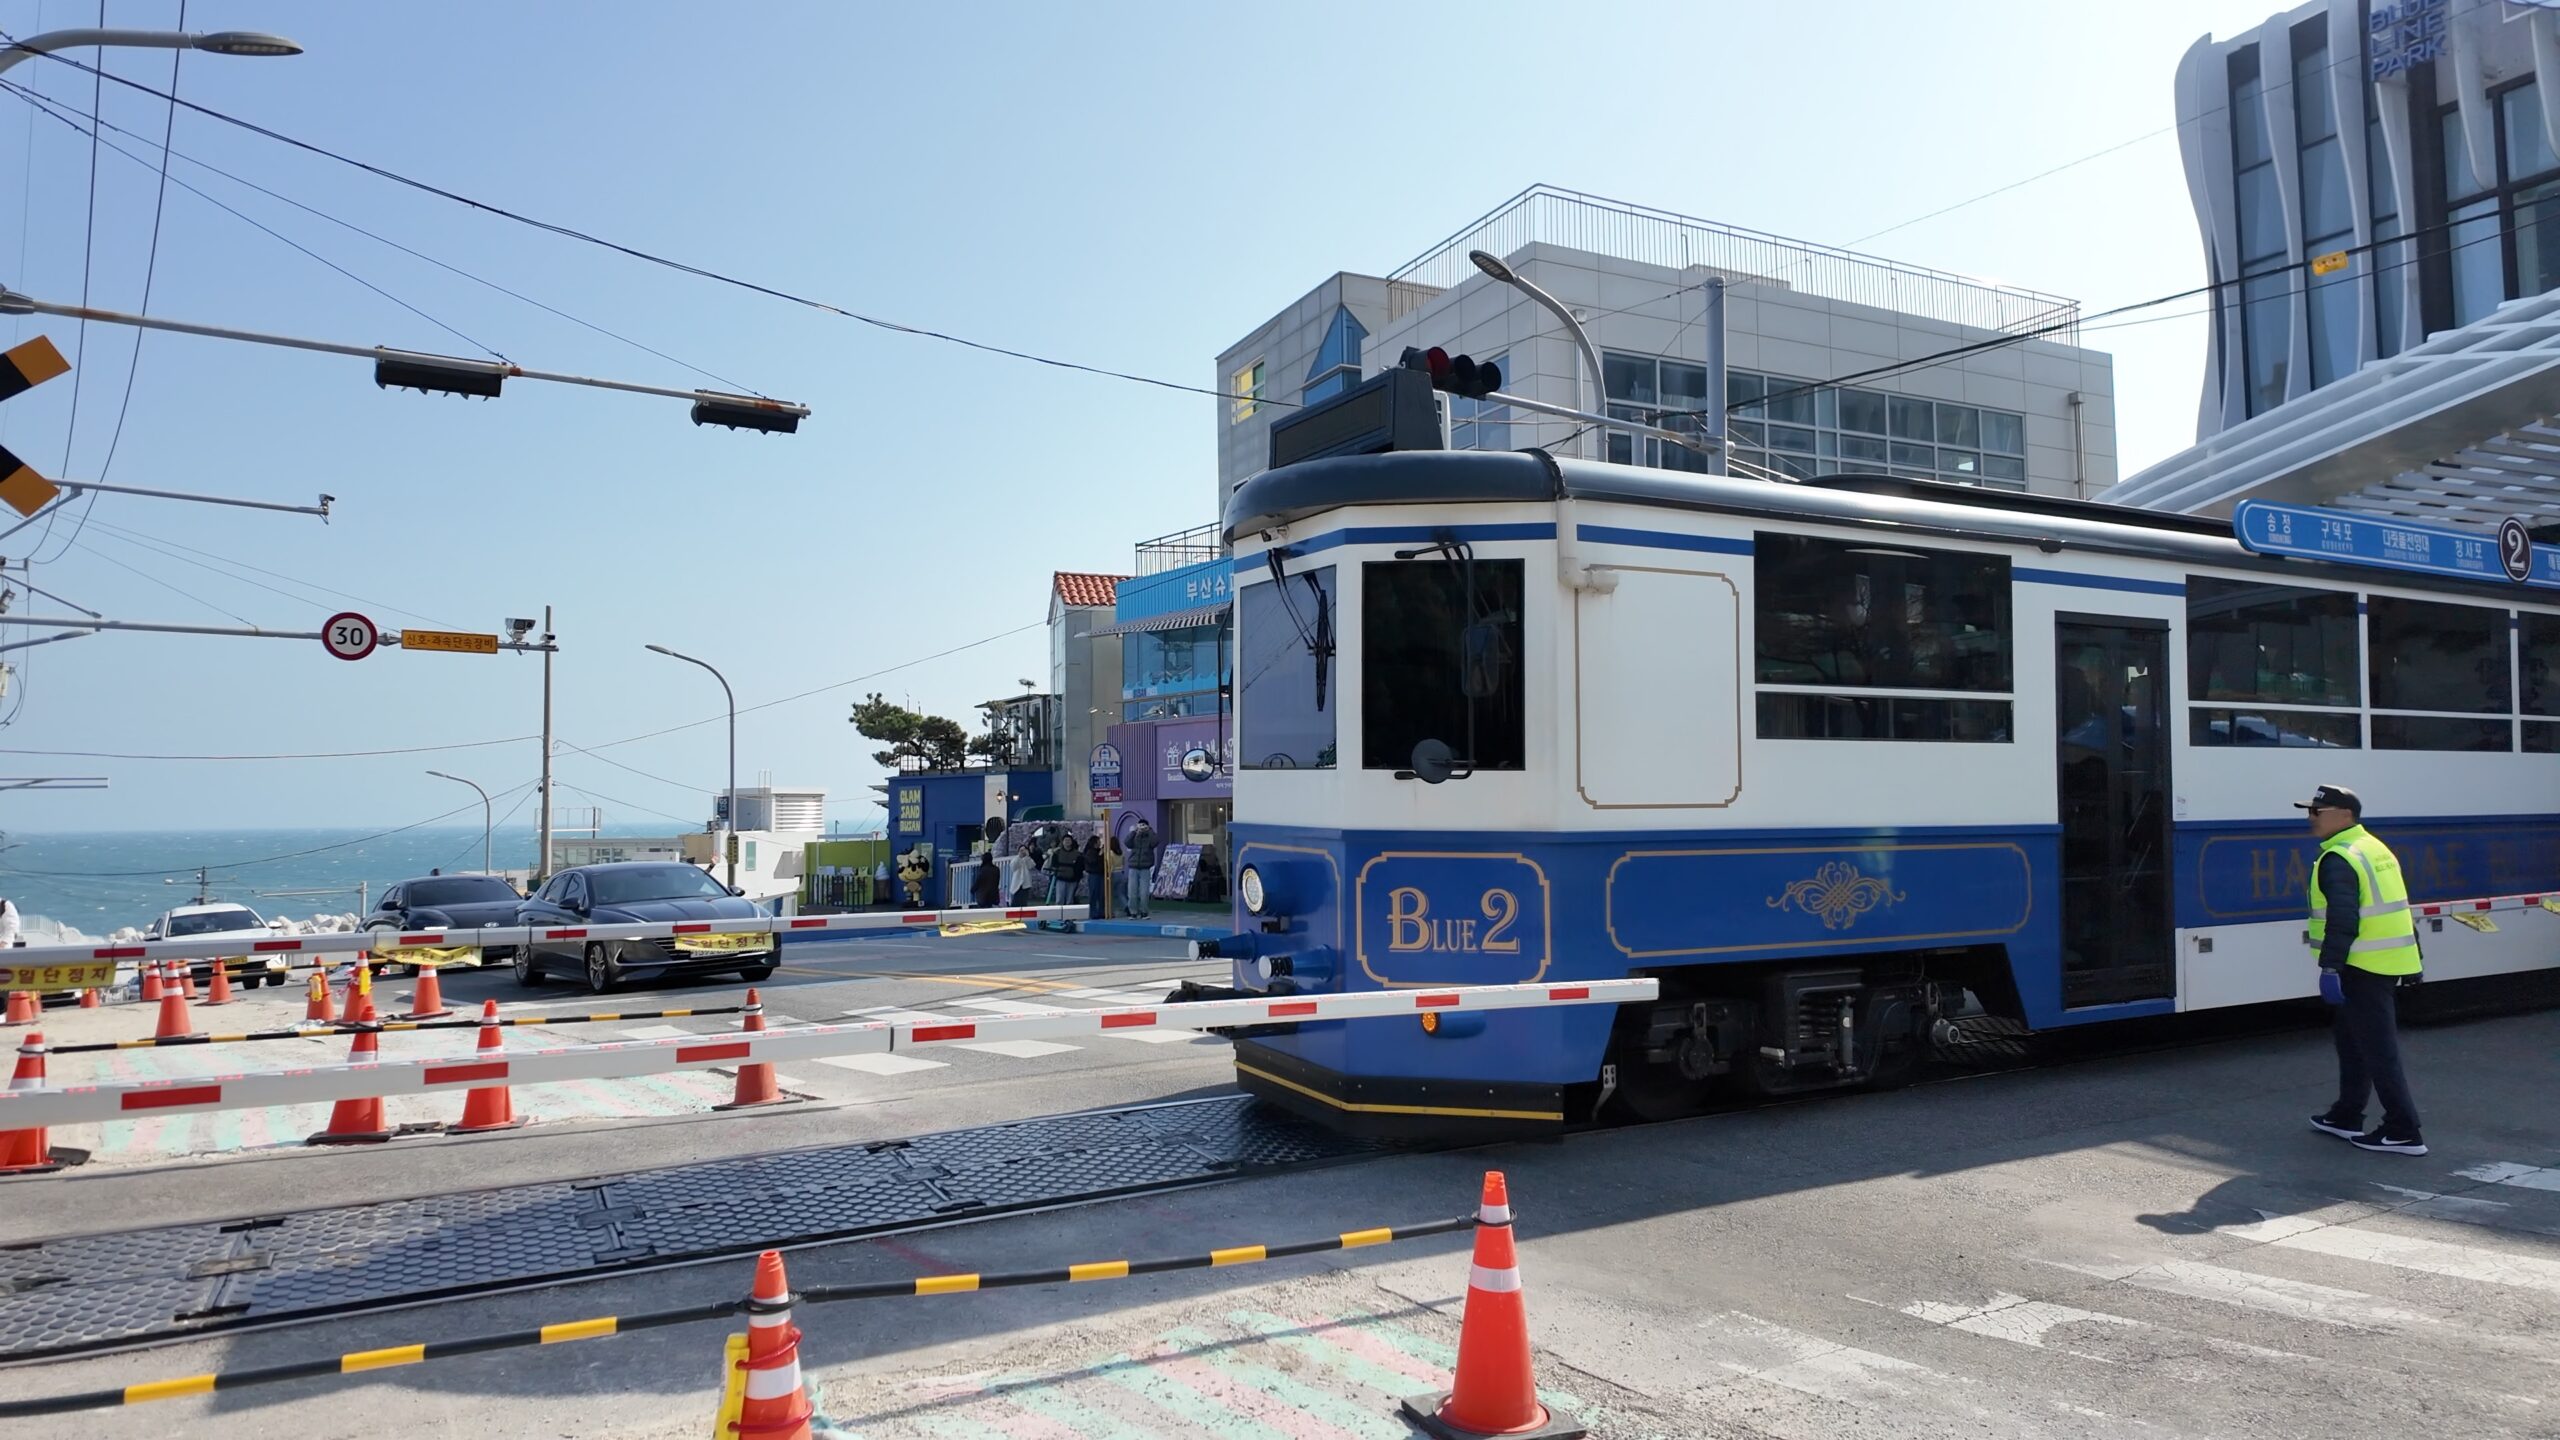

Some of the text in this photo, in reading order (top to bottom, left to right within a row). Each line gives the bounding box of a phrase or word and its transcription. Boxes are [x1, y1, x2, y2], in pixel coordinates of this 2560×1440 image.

[2370, 10, 2446, 58] LINE
[2370, 31, 2448, 82] PARK
[2321, 520, 2353, 541] 구덕포
[2507, 528, 2527, 571] 2
[335, 626, 364, 647] 30
[900, 789, 921, 804] GLAM
[900, 804, 920, 819] SAND
[900, 820, 921, 832] BUSAN
